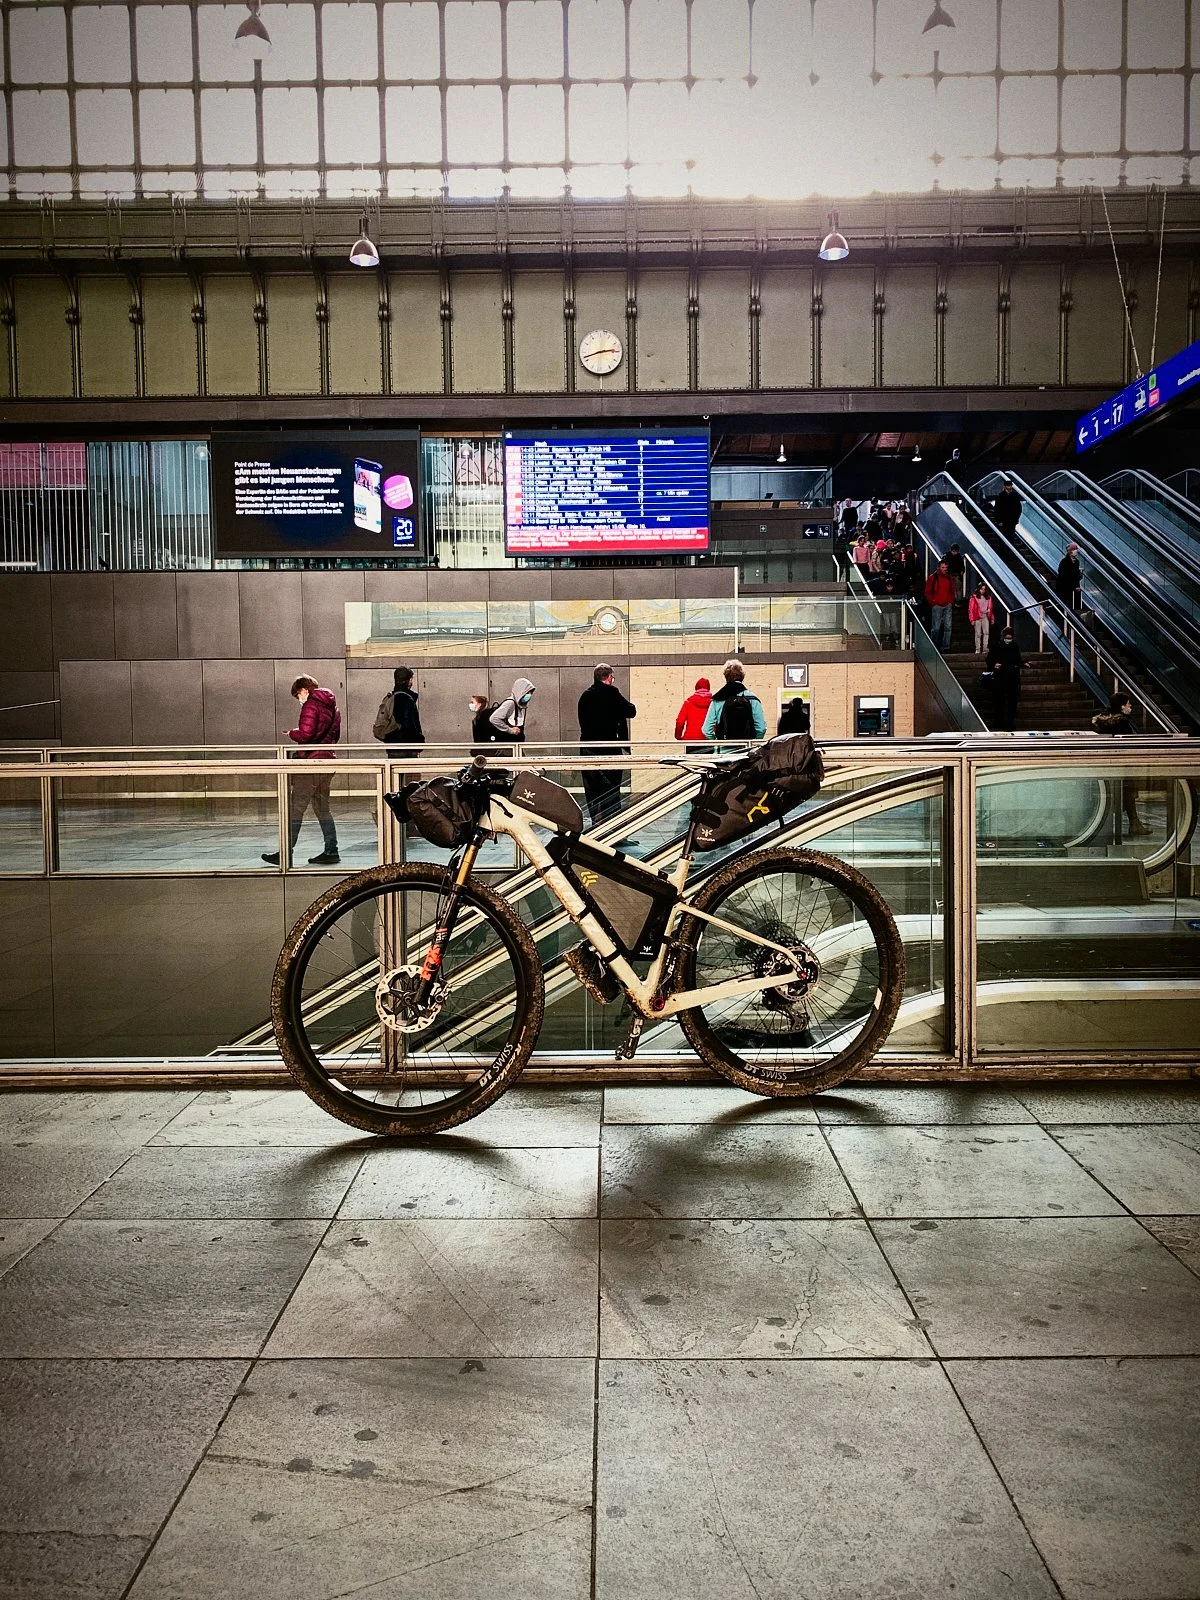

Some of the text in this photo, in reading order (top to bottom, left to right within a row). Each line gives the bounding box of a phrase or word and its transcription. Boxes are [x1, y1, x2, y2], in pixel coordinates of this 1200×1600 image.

[1112, 404, 1123, 425] 17
[235, 477, 249, 485] gibt
[396, 519, 412, 536] 20
[292, 898, 341, 957] CONTINENTAL
[479, 1042, 514, 1088] DT SWISS
[744, 1063, 788, 1081] DT SWISS
